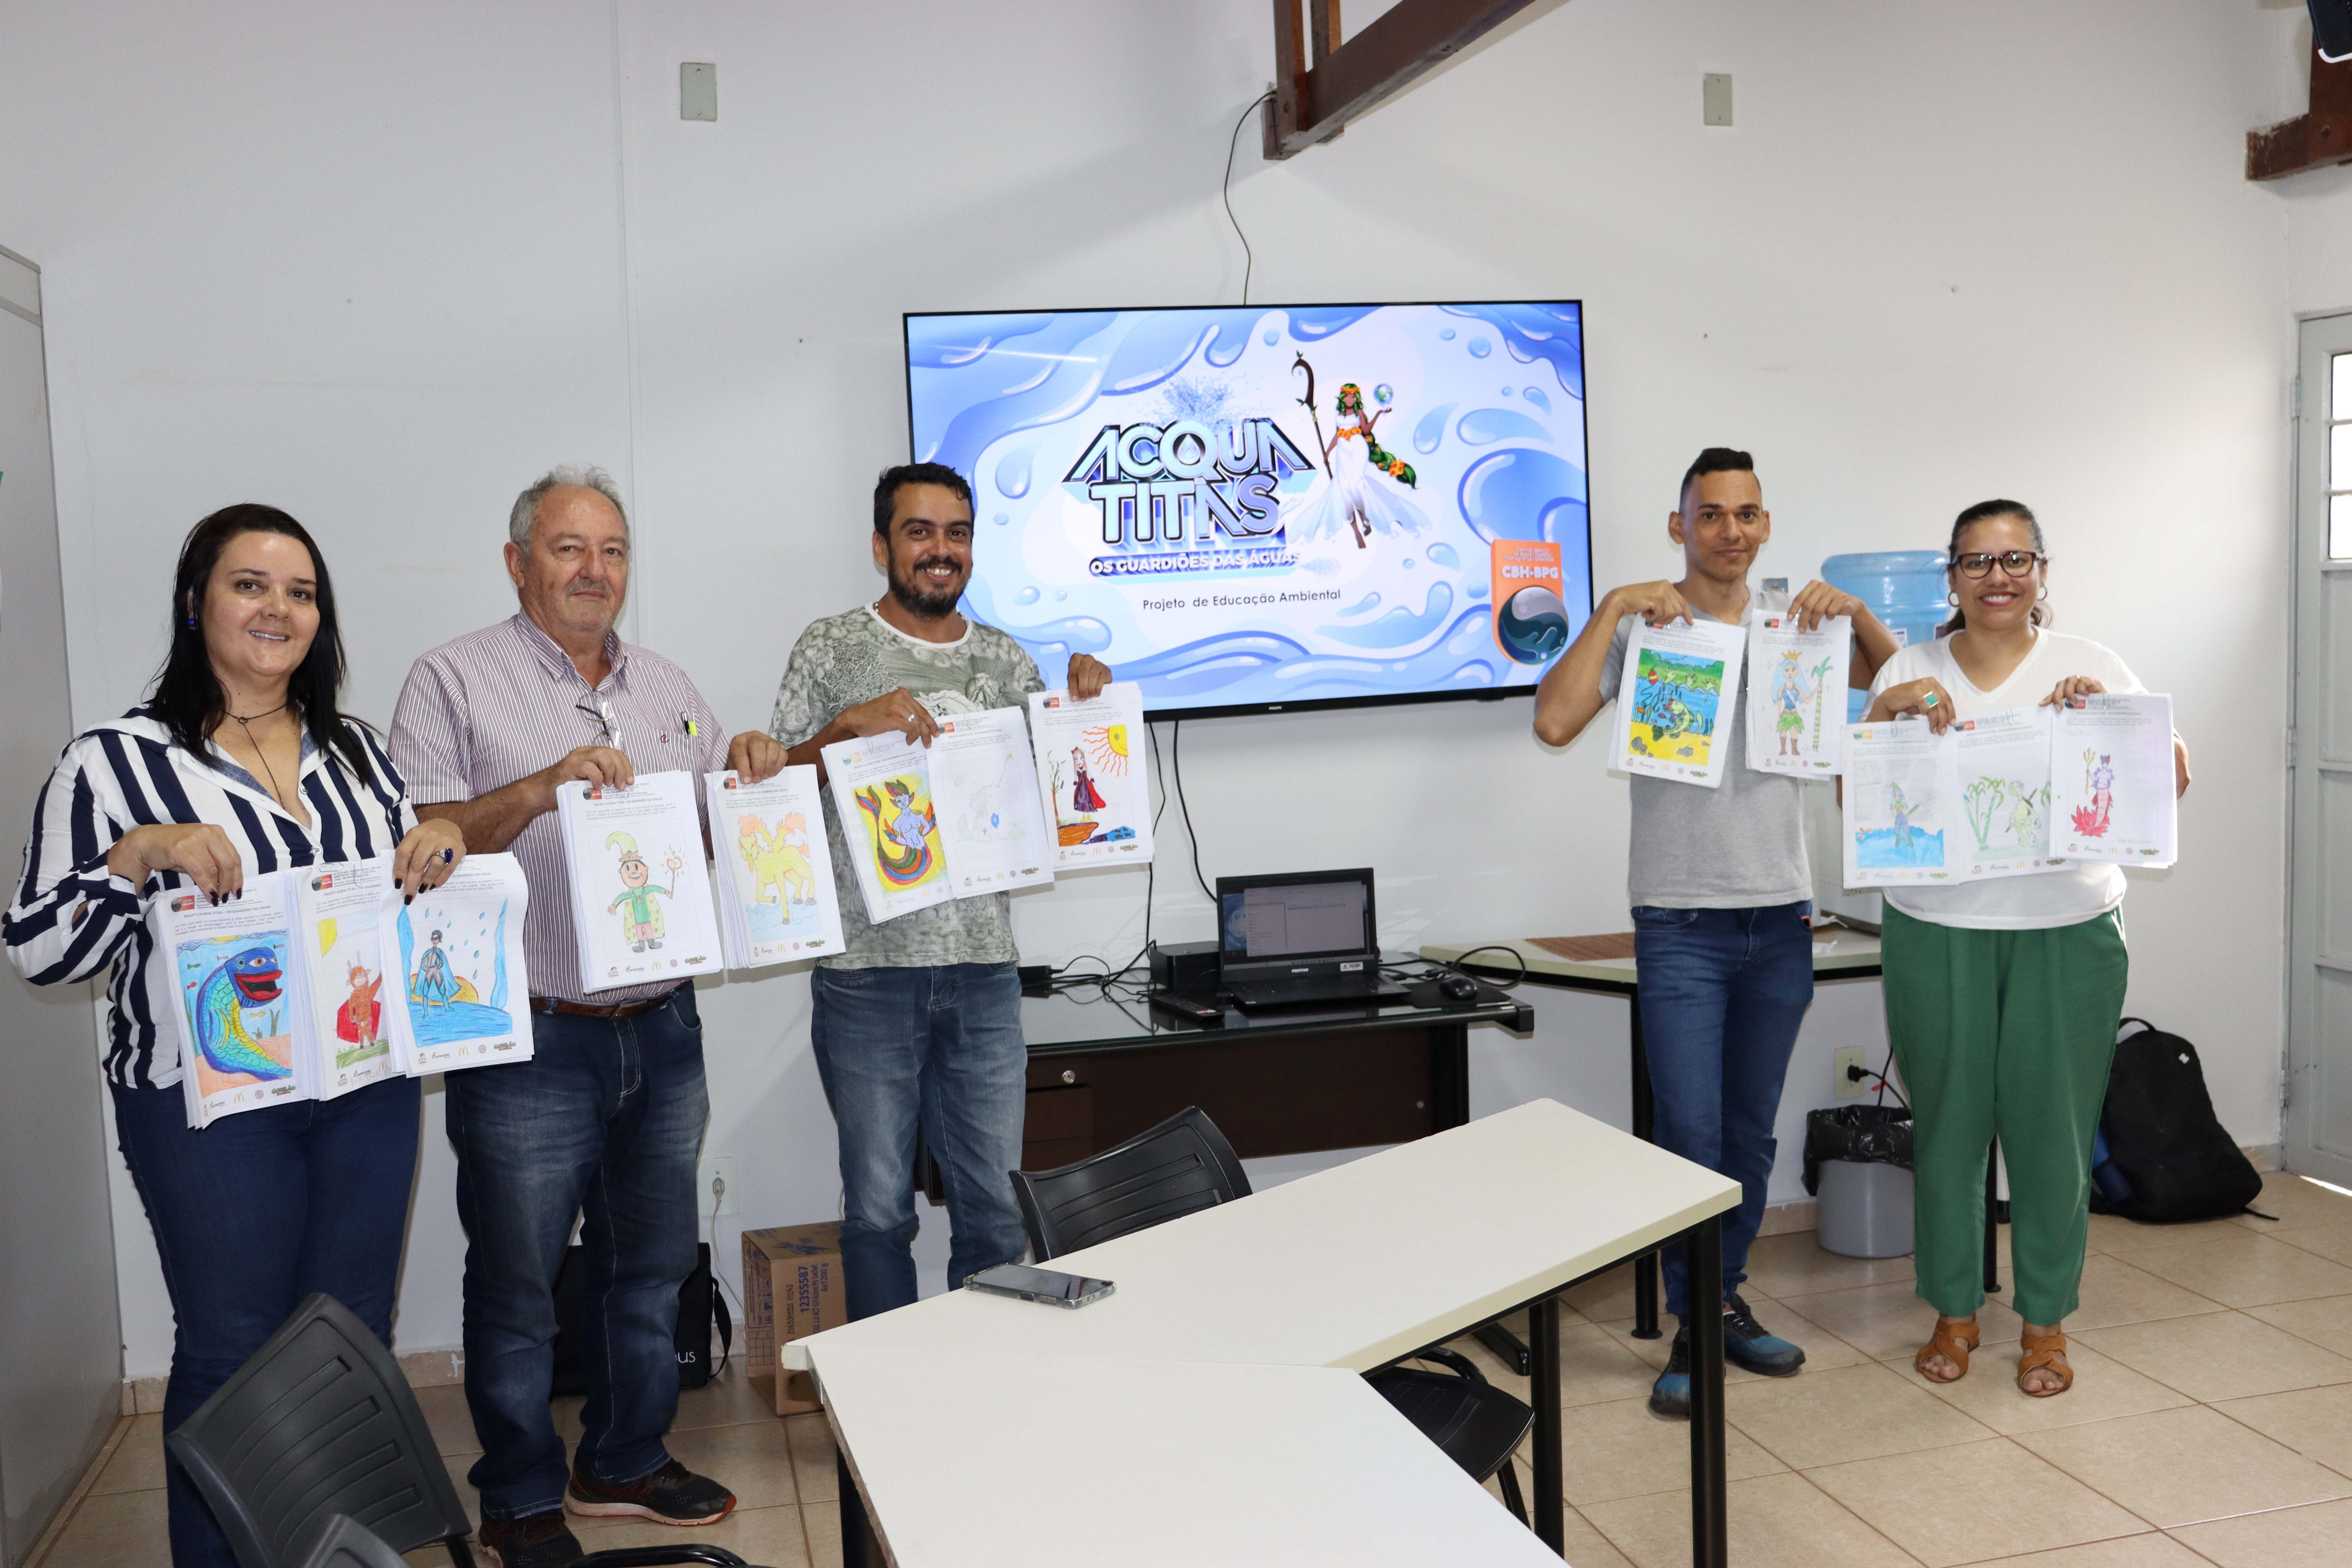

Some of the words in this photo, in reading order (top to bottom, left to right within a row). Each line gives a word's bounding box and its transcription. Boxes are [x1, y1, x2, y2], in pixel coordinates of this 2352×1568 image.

[1062, 418, 1316, 481] ACQUA
[1092, 561, 1113, 574] OS
[1116, 552, 1209, 572] GUARDIÕES
[1211, 554, 1243, 569] DAS
[1249, 548, 1301, 564] ÁGUAS
[1502, 565, 1559, 579] CBH-BPG
[1143, 598, 1185, 611] Projeto
[1193, 596, 1208, 607] de
[1213, 592, 1274, 606] Educação
[1279, 588, 1341, 603] Ambiental
[798, 1266, 809, 1313] 12355587
[675, 1352, 696, 1363] us
